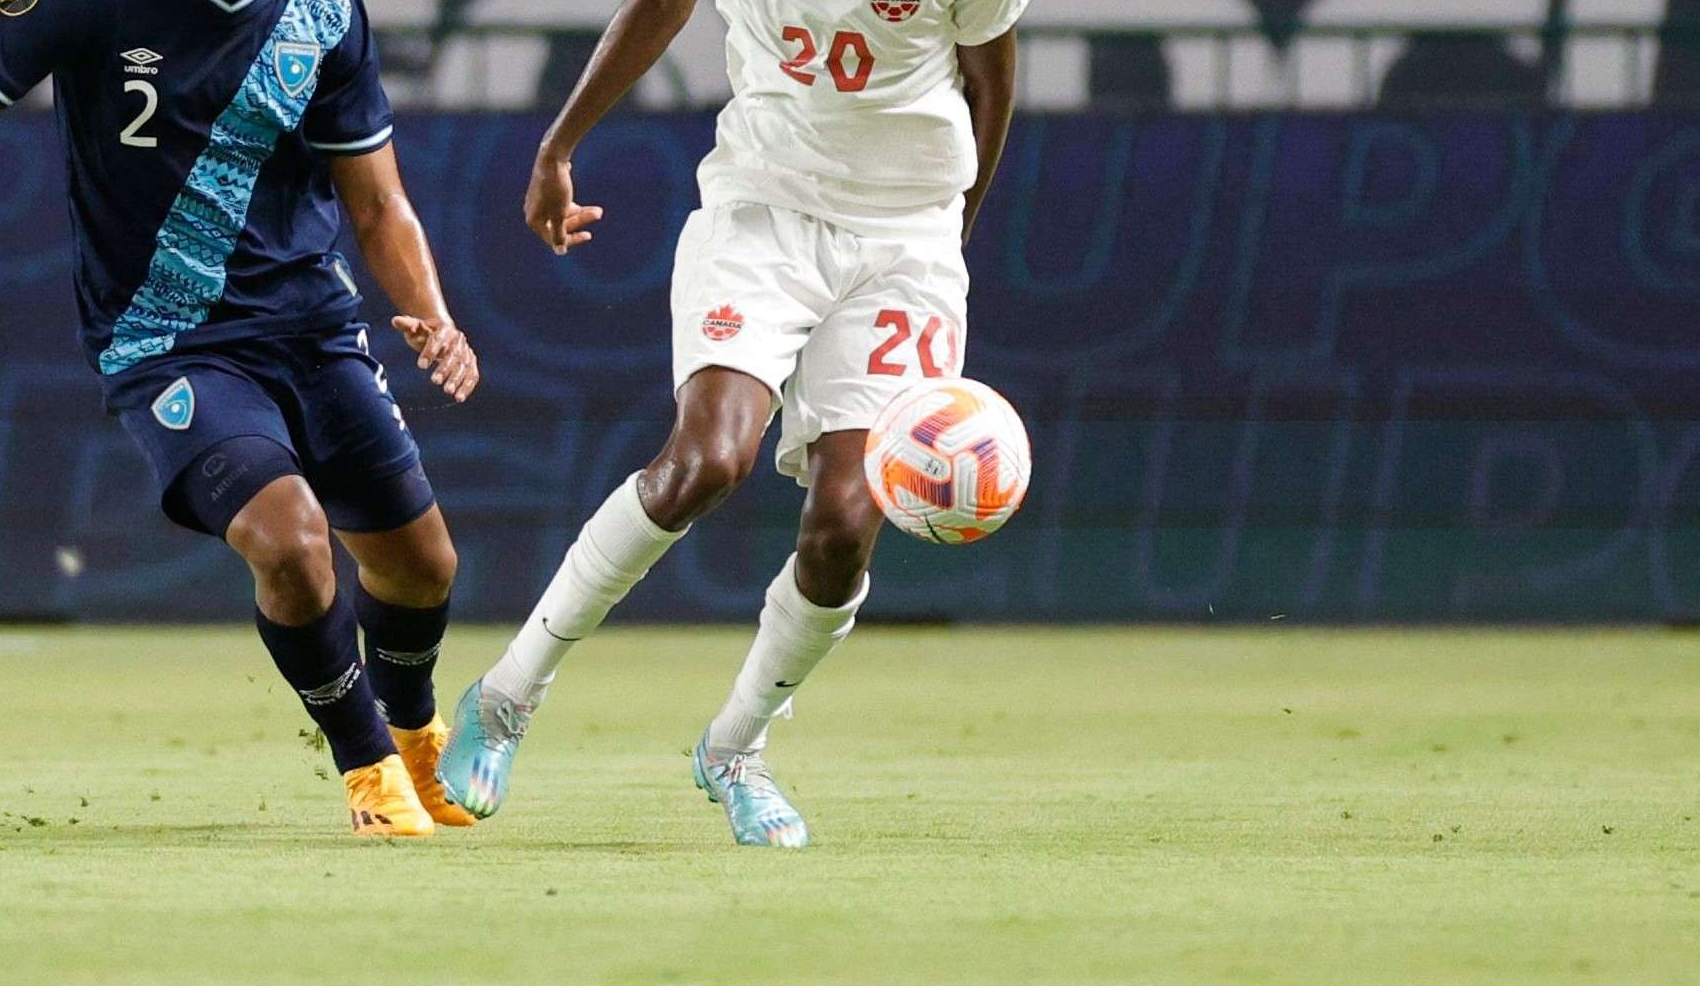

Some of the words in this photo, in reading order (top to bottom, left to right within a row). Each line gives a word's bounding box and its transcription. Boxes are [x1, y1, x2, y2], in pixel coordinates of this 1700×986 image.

[124, 65, 158, 74] umbro
[780, 26, 875, 92] 20
[120, 80, 158, 147] 2
[867, 309, 956, 378] 20
